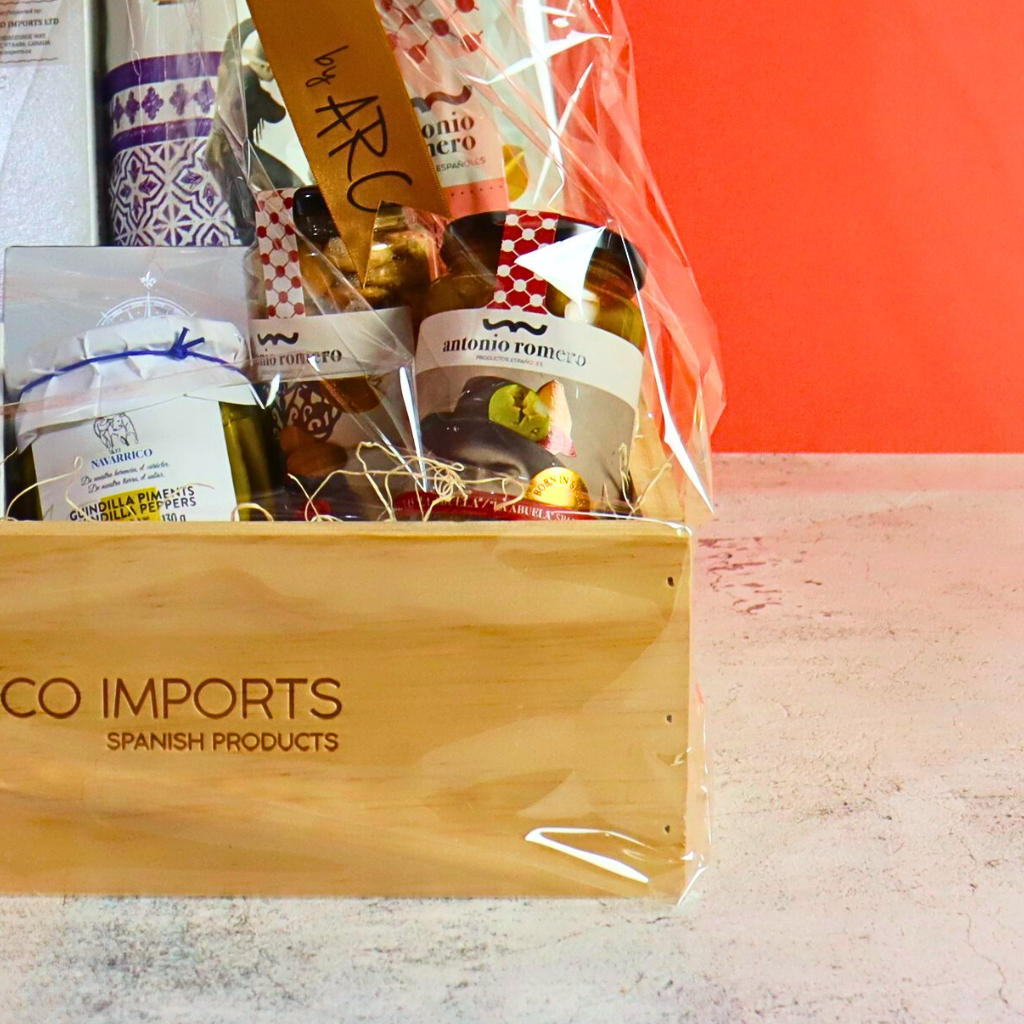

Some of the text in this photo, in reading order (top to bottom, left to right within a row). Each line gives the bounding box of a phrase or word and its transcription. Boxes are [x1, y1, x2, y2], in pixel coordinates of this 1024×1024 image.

[44, 18, 59, 26] LTD
[305, 45, 413, 213] by ARC
[422, 111, 475, 139] onio
[442, 334, 587, 367] antonio romero
[91, 448, 153, 470] NAVARRICO
[533, 476, 557, 497] BORN
[558, 475, 569, 486] IN
[69, 485, 195, 522] GUINDILLA PIMENTS
[140, 496, 197, 514] PEPPERS
[101, 676, 343, 721] IMPORTS
[106, 731, 340, 753] SPANISH PRODUCTS
